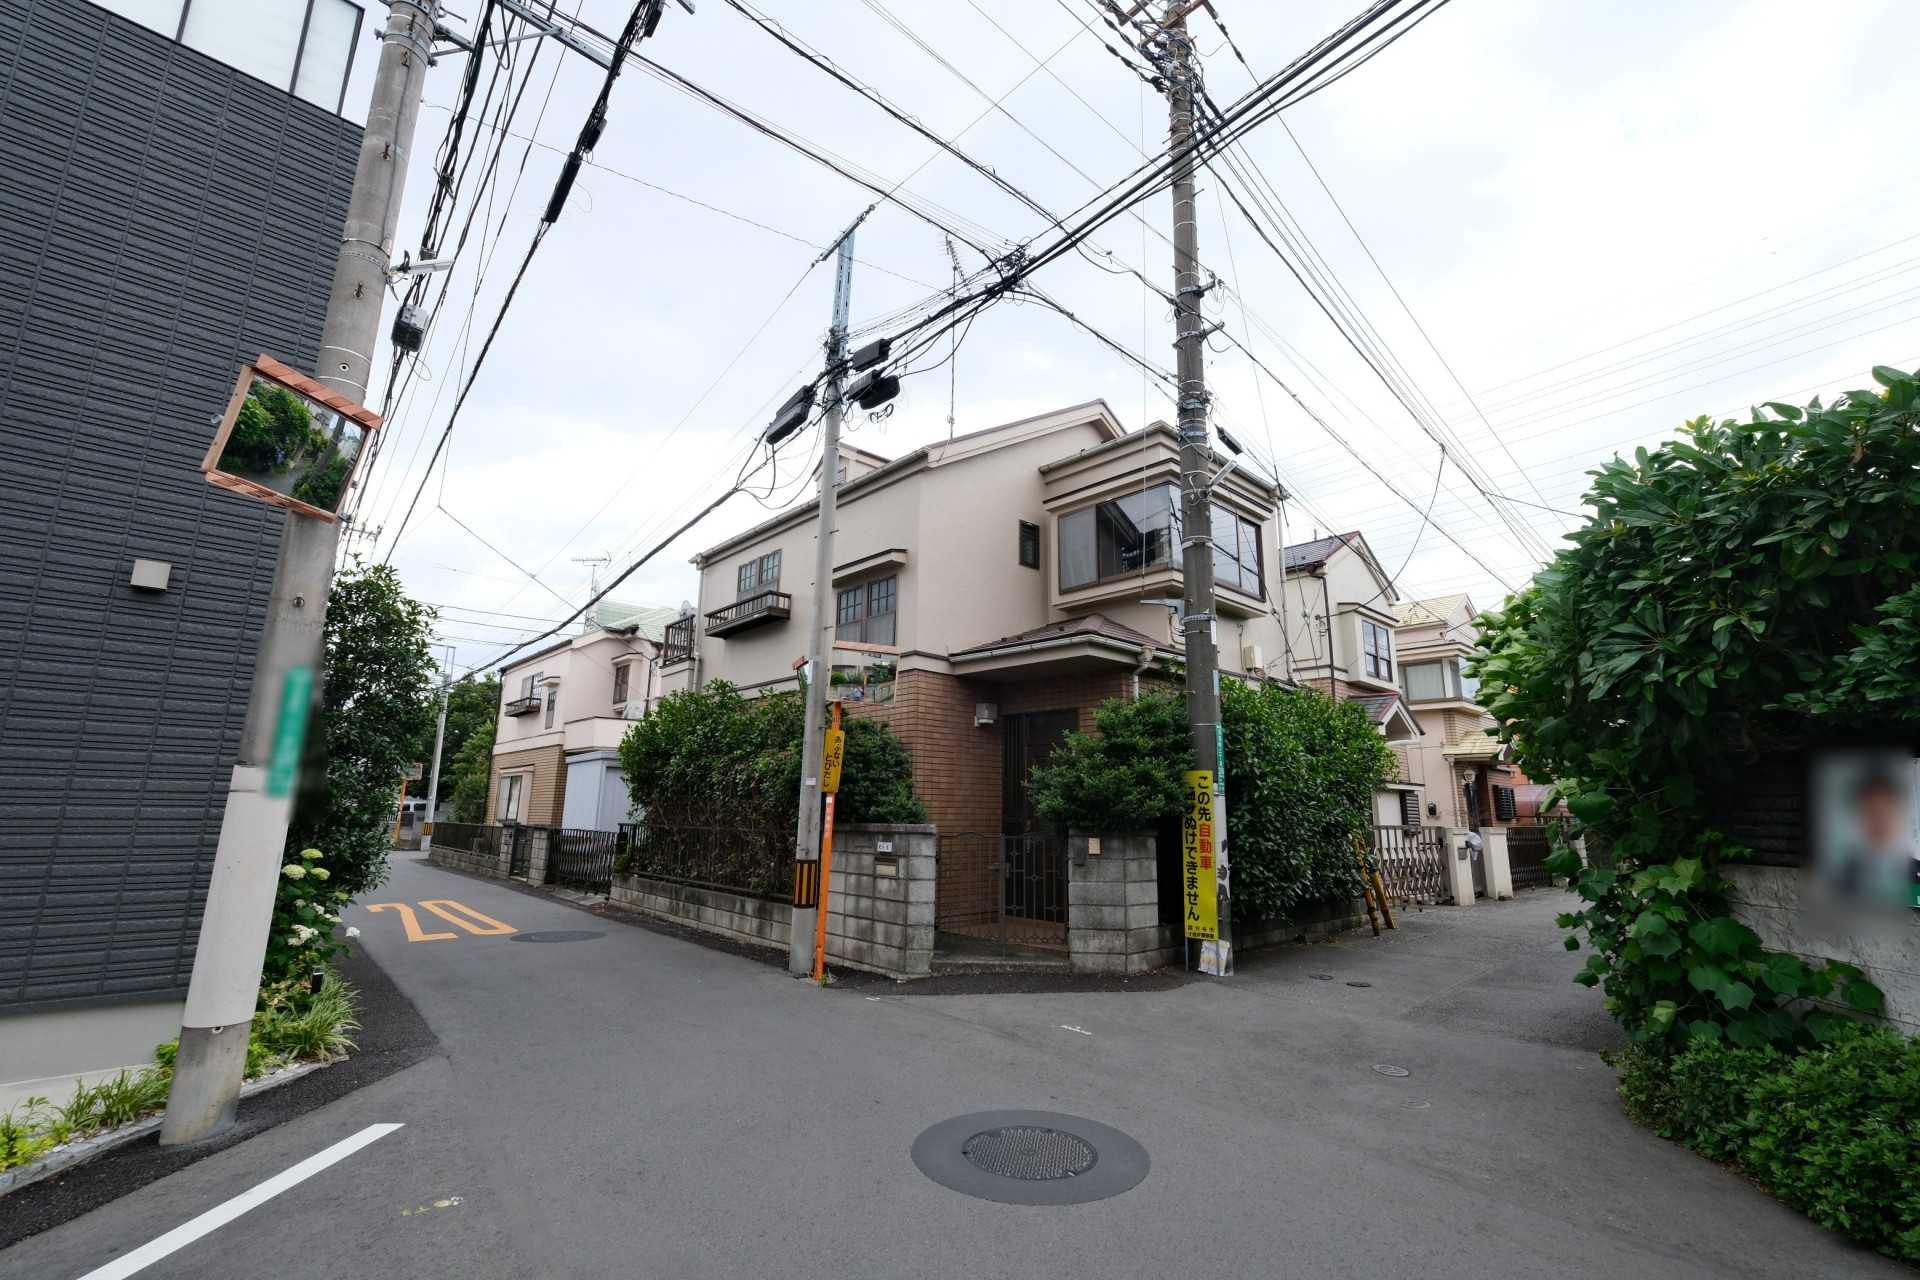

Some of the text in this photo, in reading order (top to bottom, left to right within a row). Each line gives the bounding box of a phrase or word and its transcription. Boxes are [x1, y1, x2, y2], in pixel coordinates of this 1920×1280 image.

[823, 752, 833, 787] とびだし
[833, 735, 842, 768] あぶない
[1198, 776, 1213, 869] この先自動車
[366, 900, 518, 942] 20
